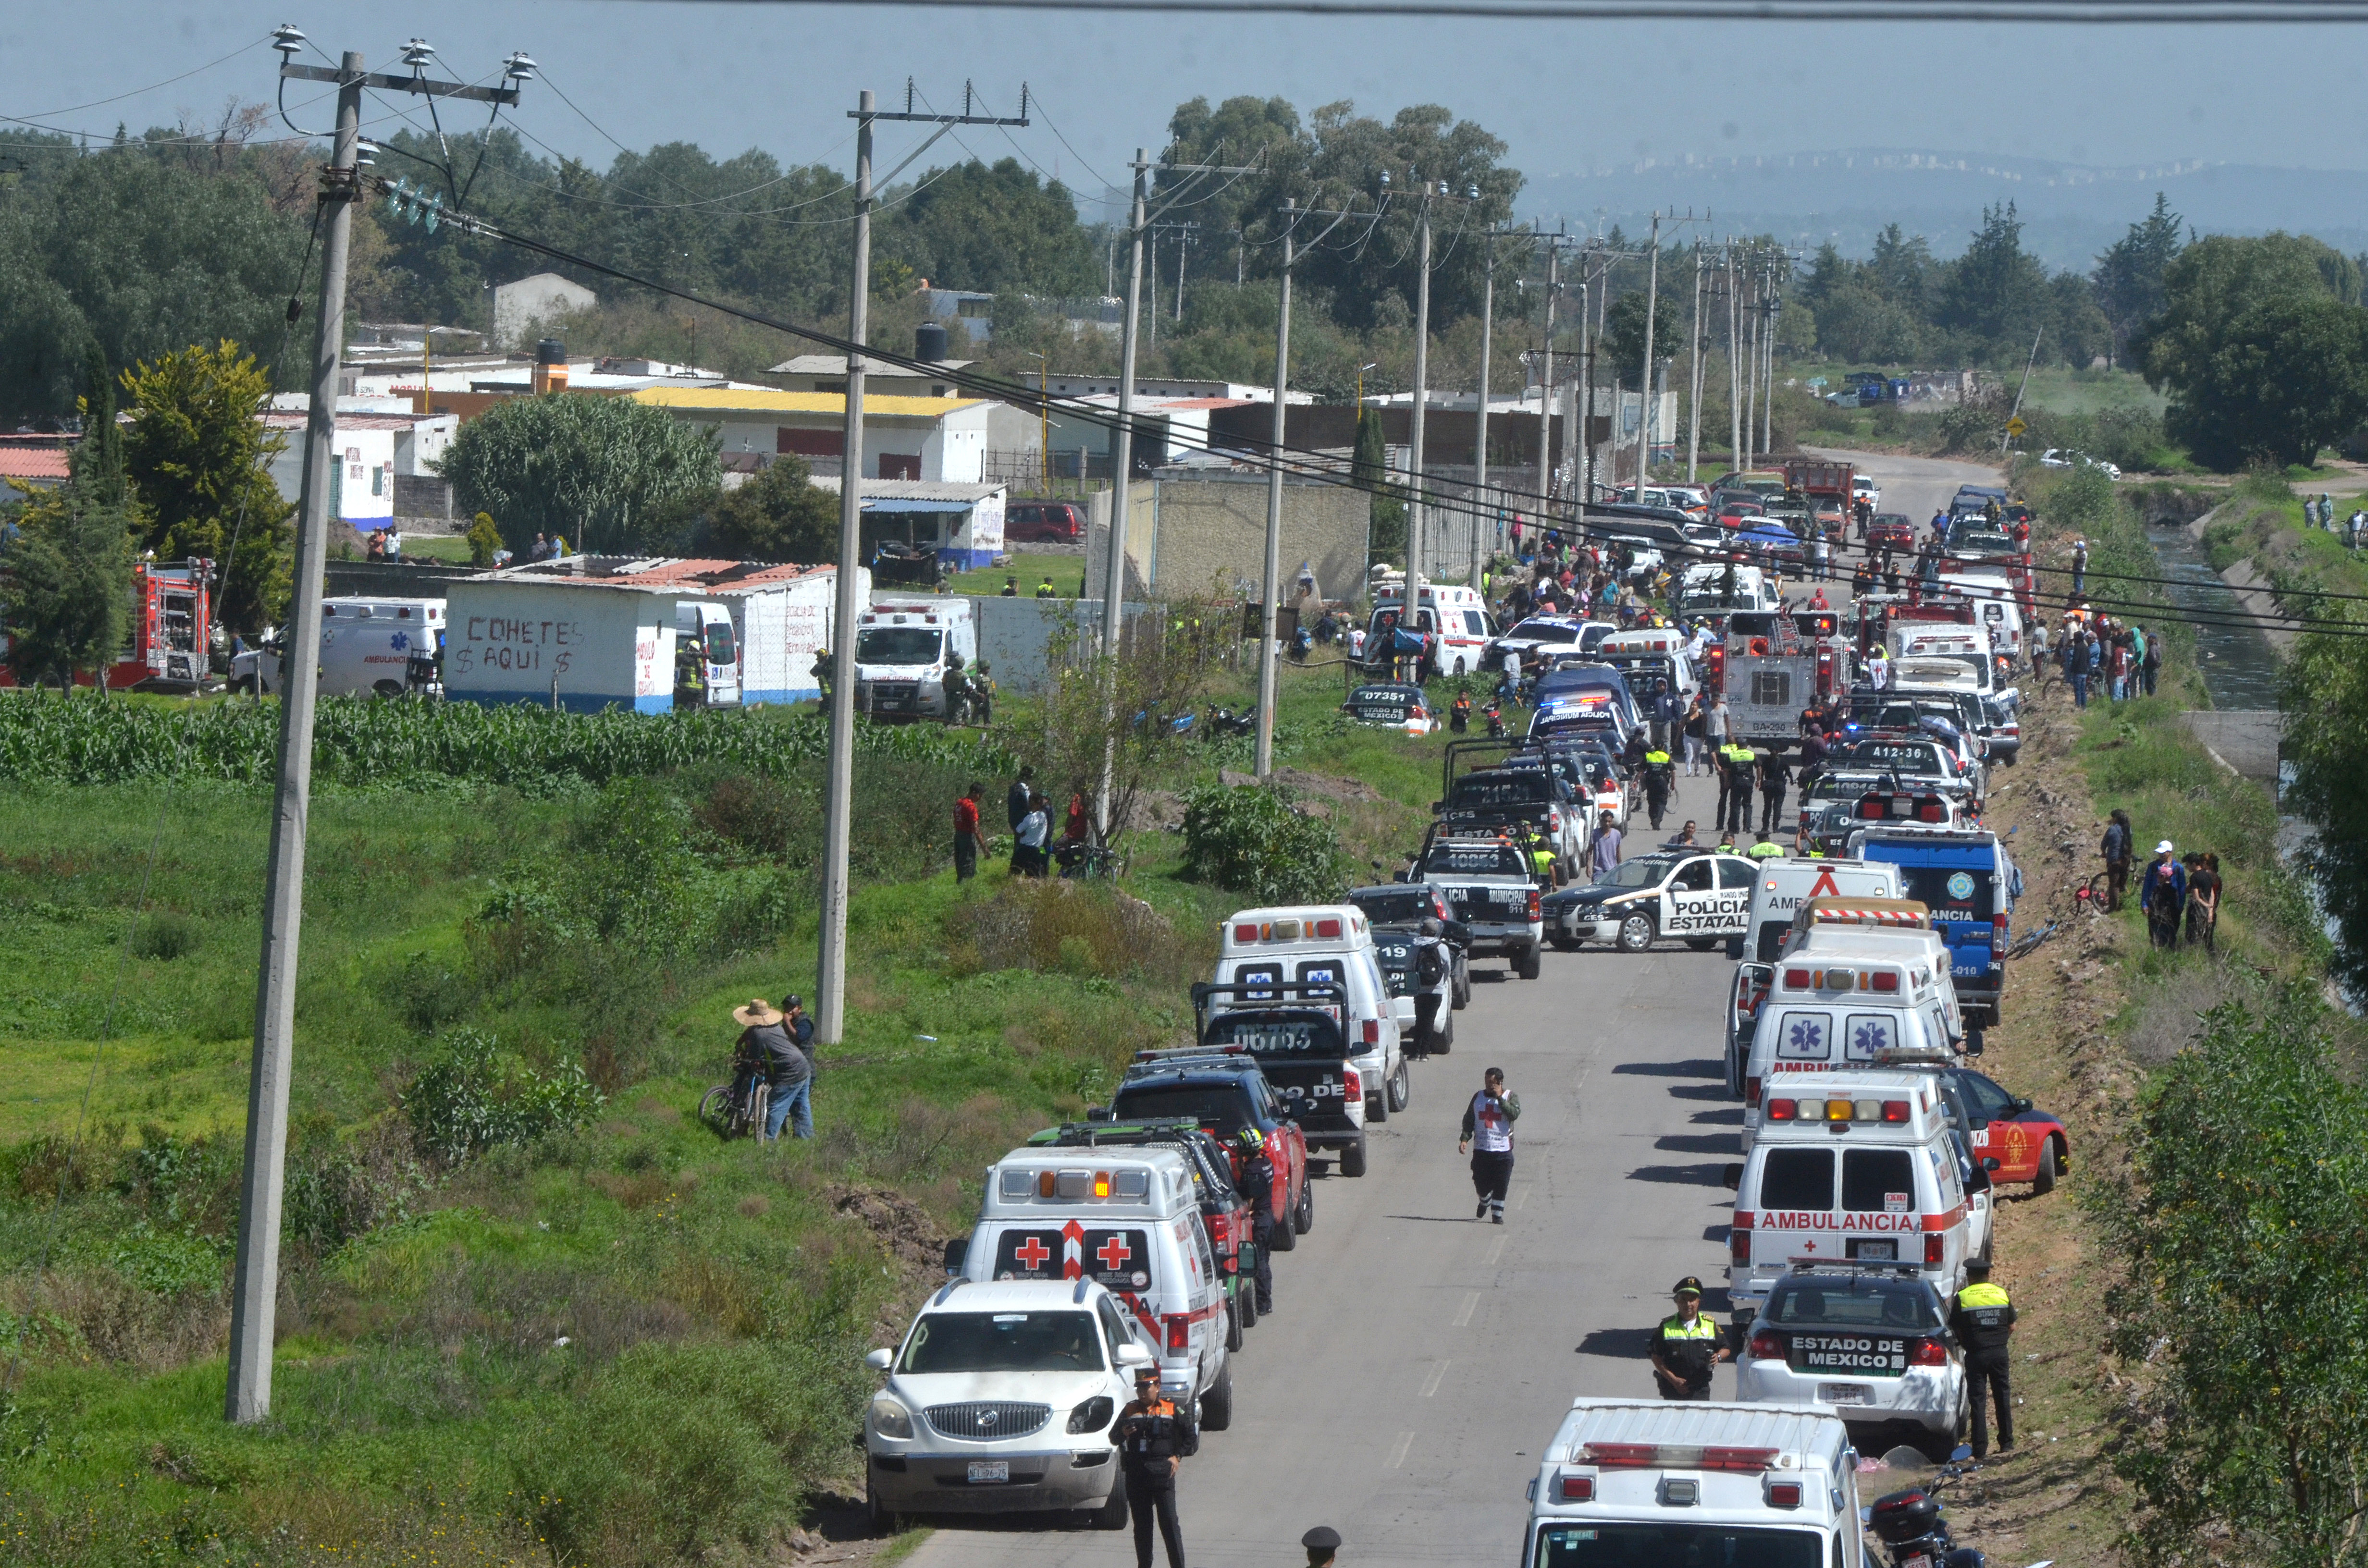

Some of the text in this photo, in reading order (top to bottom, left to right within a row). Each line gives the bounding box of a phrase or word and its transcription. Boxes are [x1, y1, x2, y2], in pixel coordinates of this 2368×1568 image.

[1365, 692, 1405, 702] 07351
[1454, 827, 1517, 838] ESTAO
[1489, 890, 1527, 904] MUNICIPAL
[1676, 900, 1750, 915] POLICIA
[1669, 915, 1747, 930] ESTATAL
[1376, 946, 1406, 957] 19
[1313, 1085, 1345, 1097] DE
[1762, 1212, 1913, 1231] AMBULANCIA
[1792, 1336, 1904, 1352] ESTADO DE
[1809, 1352, 1887, 1367] MEXICO
